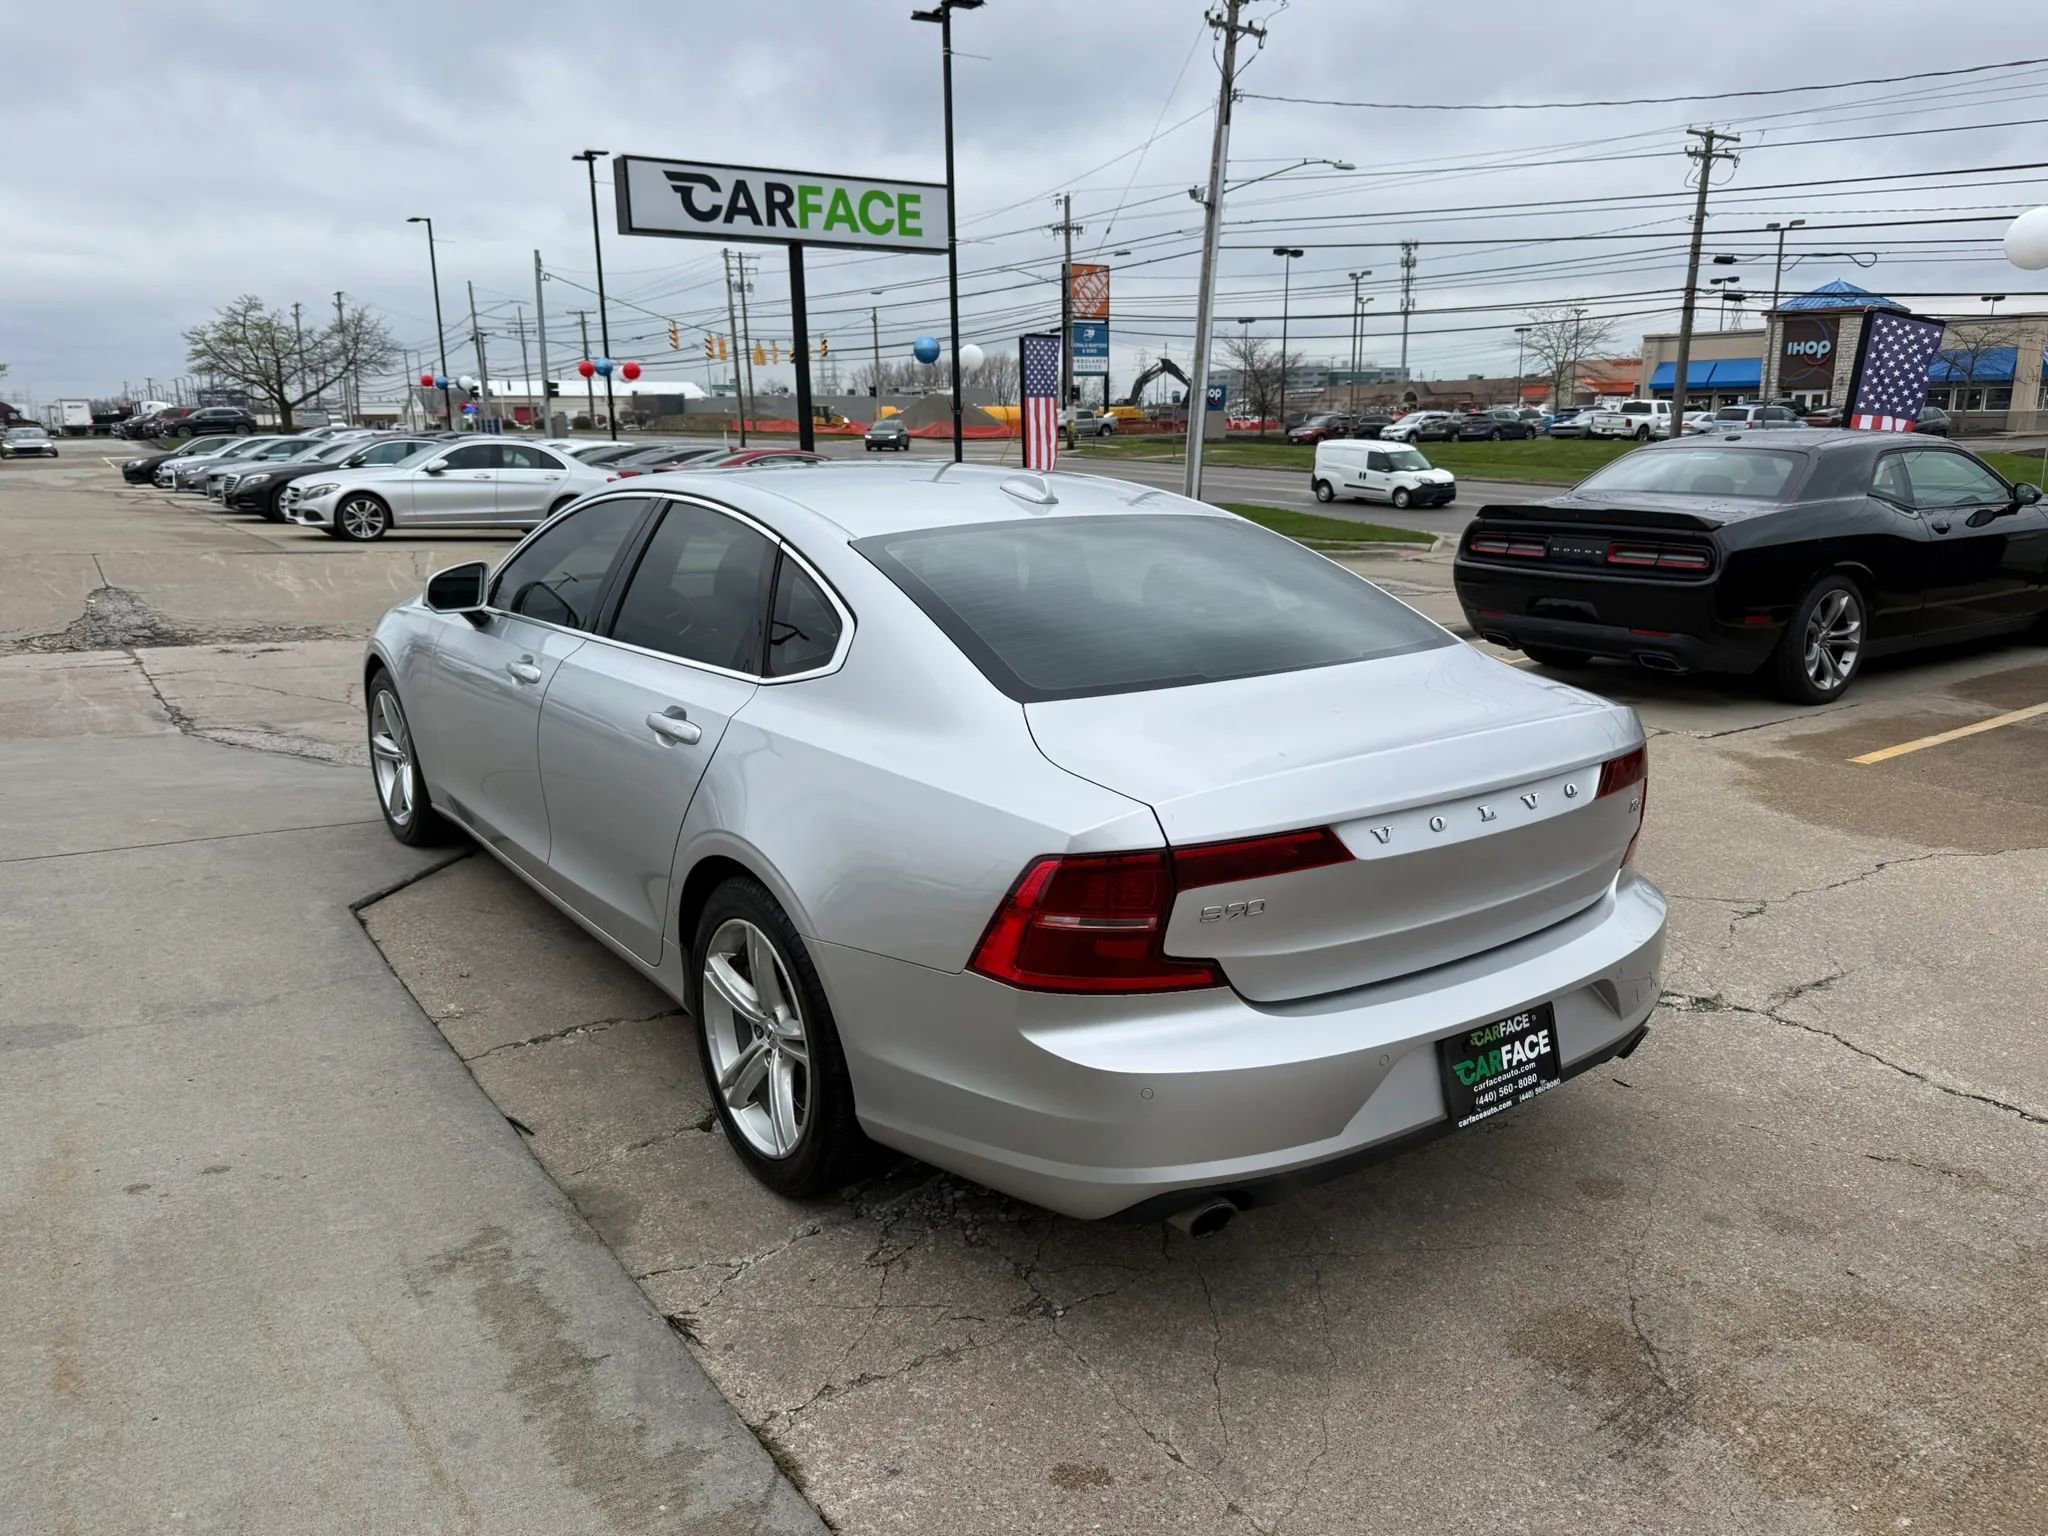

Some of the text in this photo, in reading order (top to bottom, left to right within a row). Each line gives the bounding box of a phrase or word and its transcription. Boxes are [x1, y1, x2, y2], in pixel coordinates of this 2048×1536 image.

[662, 170, 923, 237] CARFACE
[1370, 783, 1577, 843] VOLVO
[1200, 898, 1266, 923] S90
[1470, 1013, 1530, 1046] CARFACE
[1452, 1029, 1551, 1086] CARFACE
[1473, 1062, 1536, 1092] carfaceauto.com
[1458, 1100, 1513, 1128] carfaceauto.com
[1519, 1089, 1535, 1103] (440)
[1475, 1091, 1497, 1105] (440)
